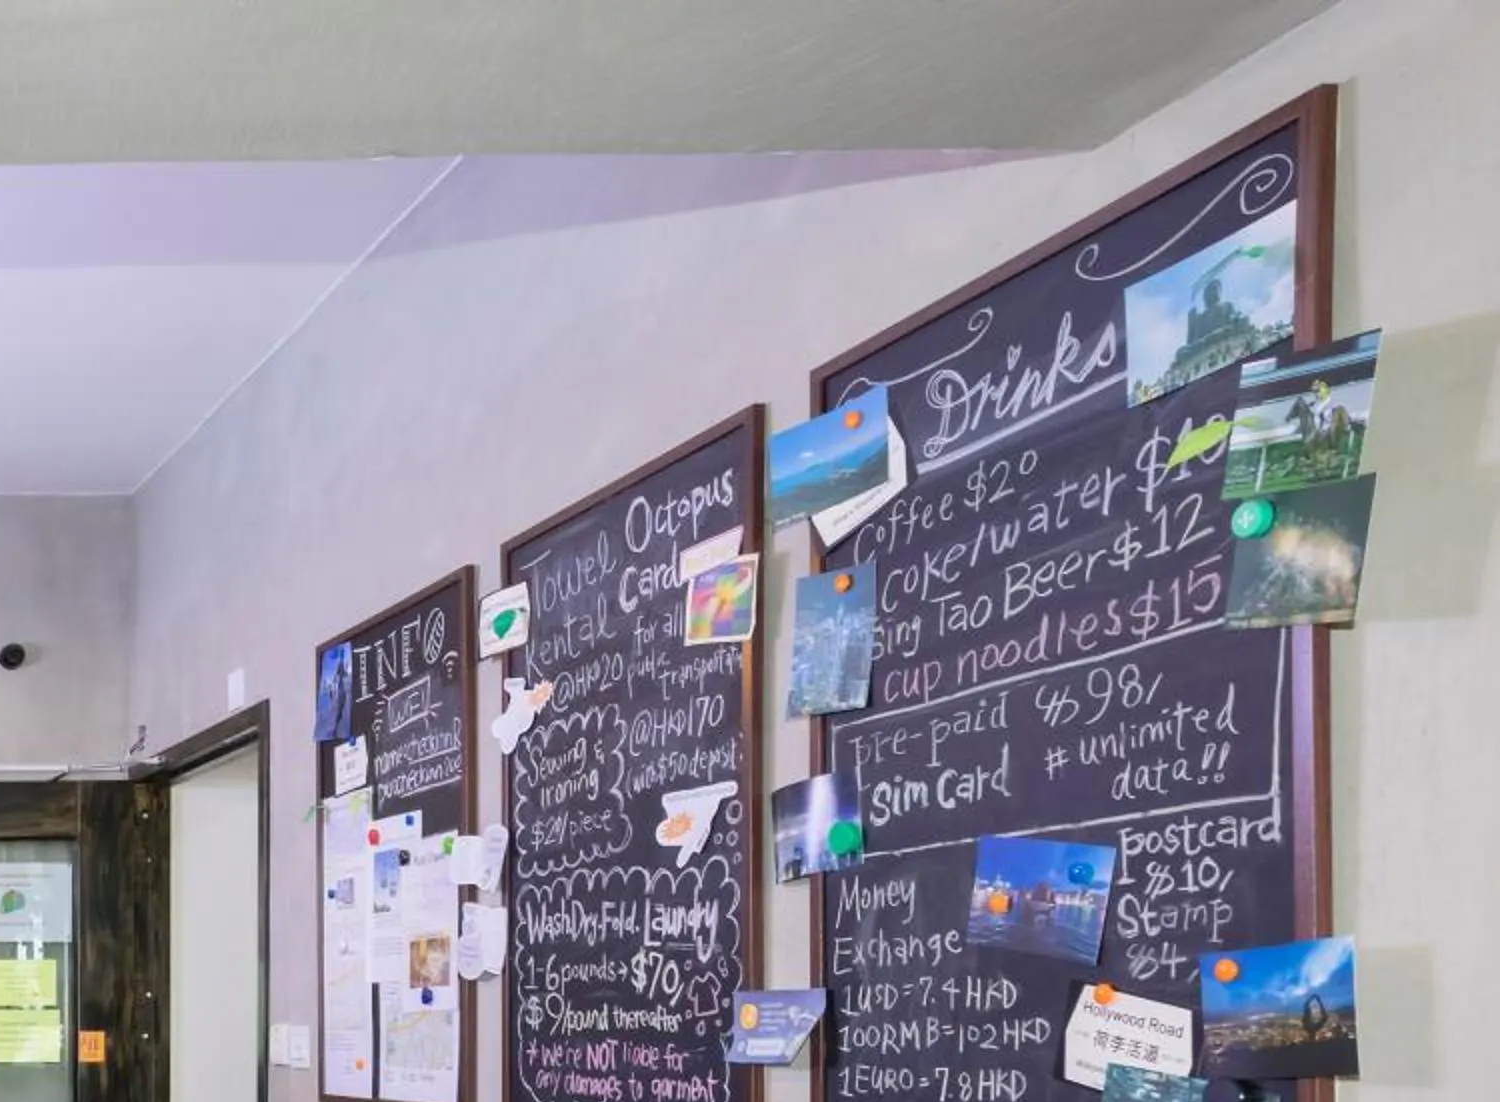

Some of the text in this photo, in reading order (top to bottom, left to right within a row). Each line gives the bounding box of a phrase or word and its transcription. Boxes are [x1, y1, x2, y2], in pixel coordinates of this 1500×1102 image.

[924, 310, 1117, 459] Drinks
[625, 468, 734, 553] Octopus
[853, 492, 954, 566] Coffee
[519, 530, 618, 619] Towel
[931, 590, 993, 637] Tao
[1003, 548, 1106, 621] Beer
[1108, 493, 1215, 572] $12
[353, 608, 446, 703] INFO
[634, 614, 658, 655] for
[884, 554, 1223, 704] cup noodles $15
[1079, 682, 1240, 765] unlimited
[528, 737, 587, 788] Sewing
[936, 742, 1012, 810] Card
[835, 874, 916, 929] Money
[1116, 893, 1233, 943] Stamp
[561, 953, 617, 996] pounds
[833, 927, 963, 976] Exchange
[1083, 1000, 1185, 1039] Hollywood Road
[586, 1037, 619, 1072] NOT
[663, 1042, 689, 1073] for
[627, 1072, 644, 1102] to
